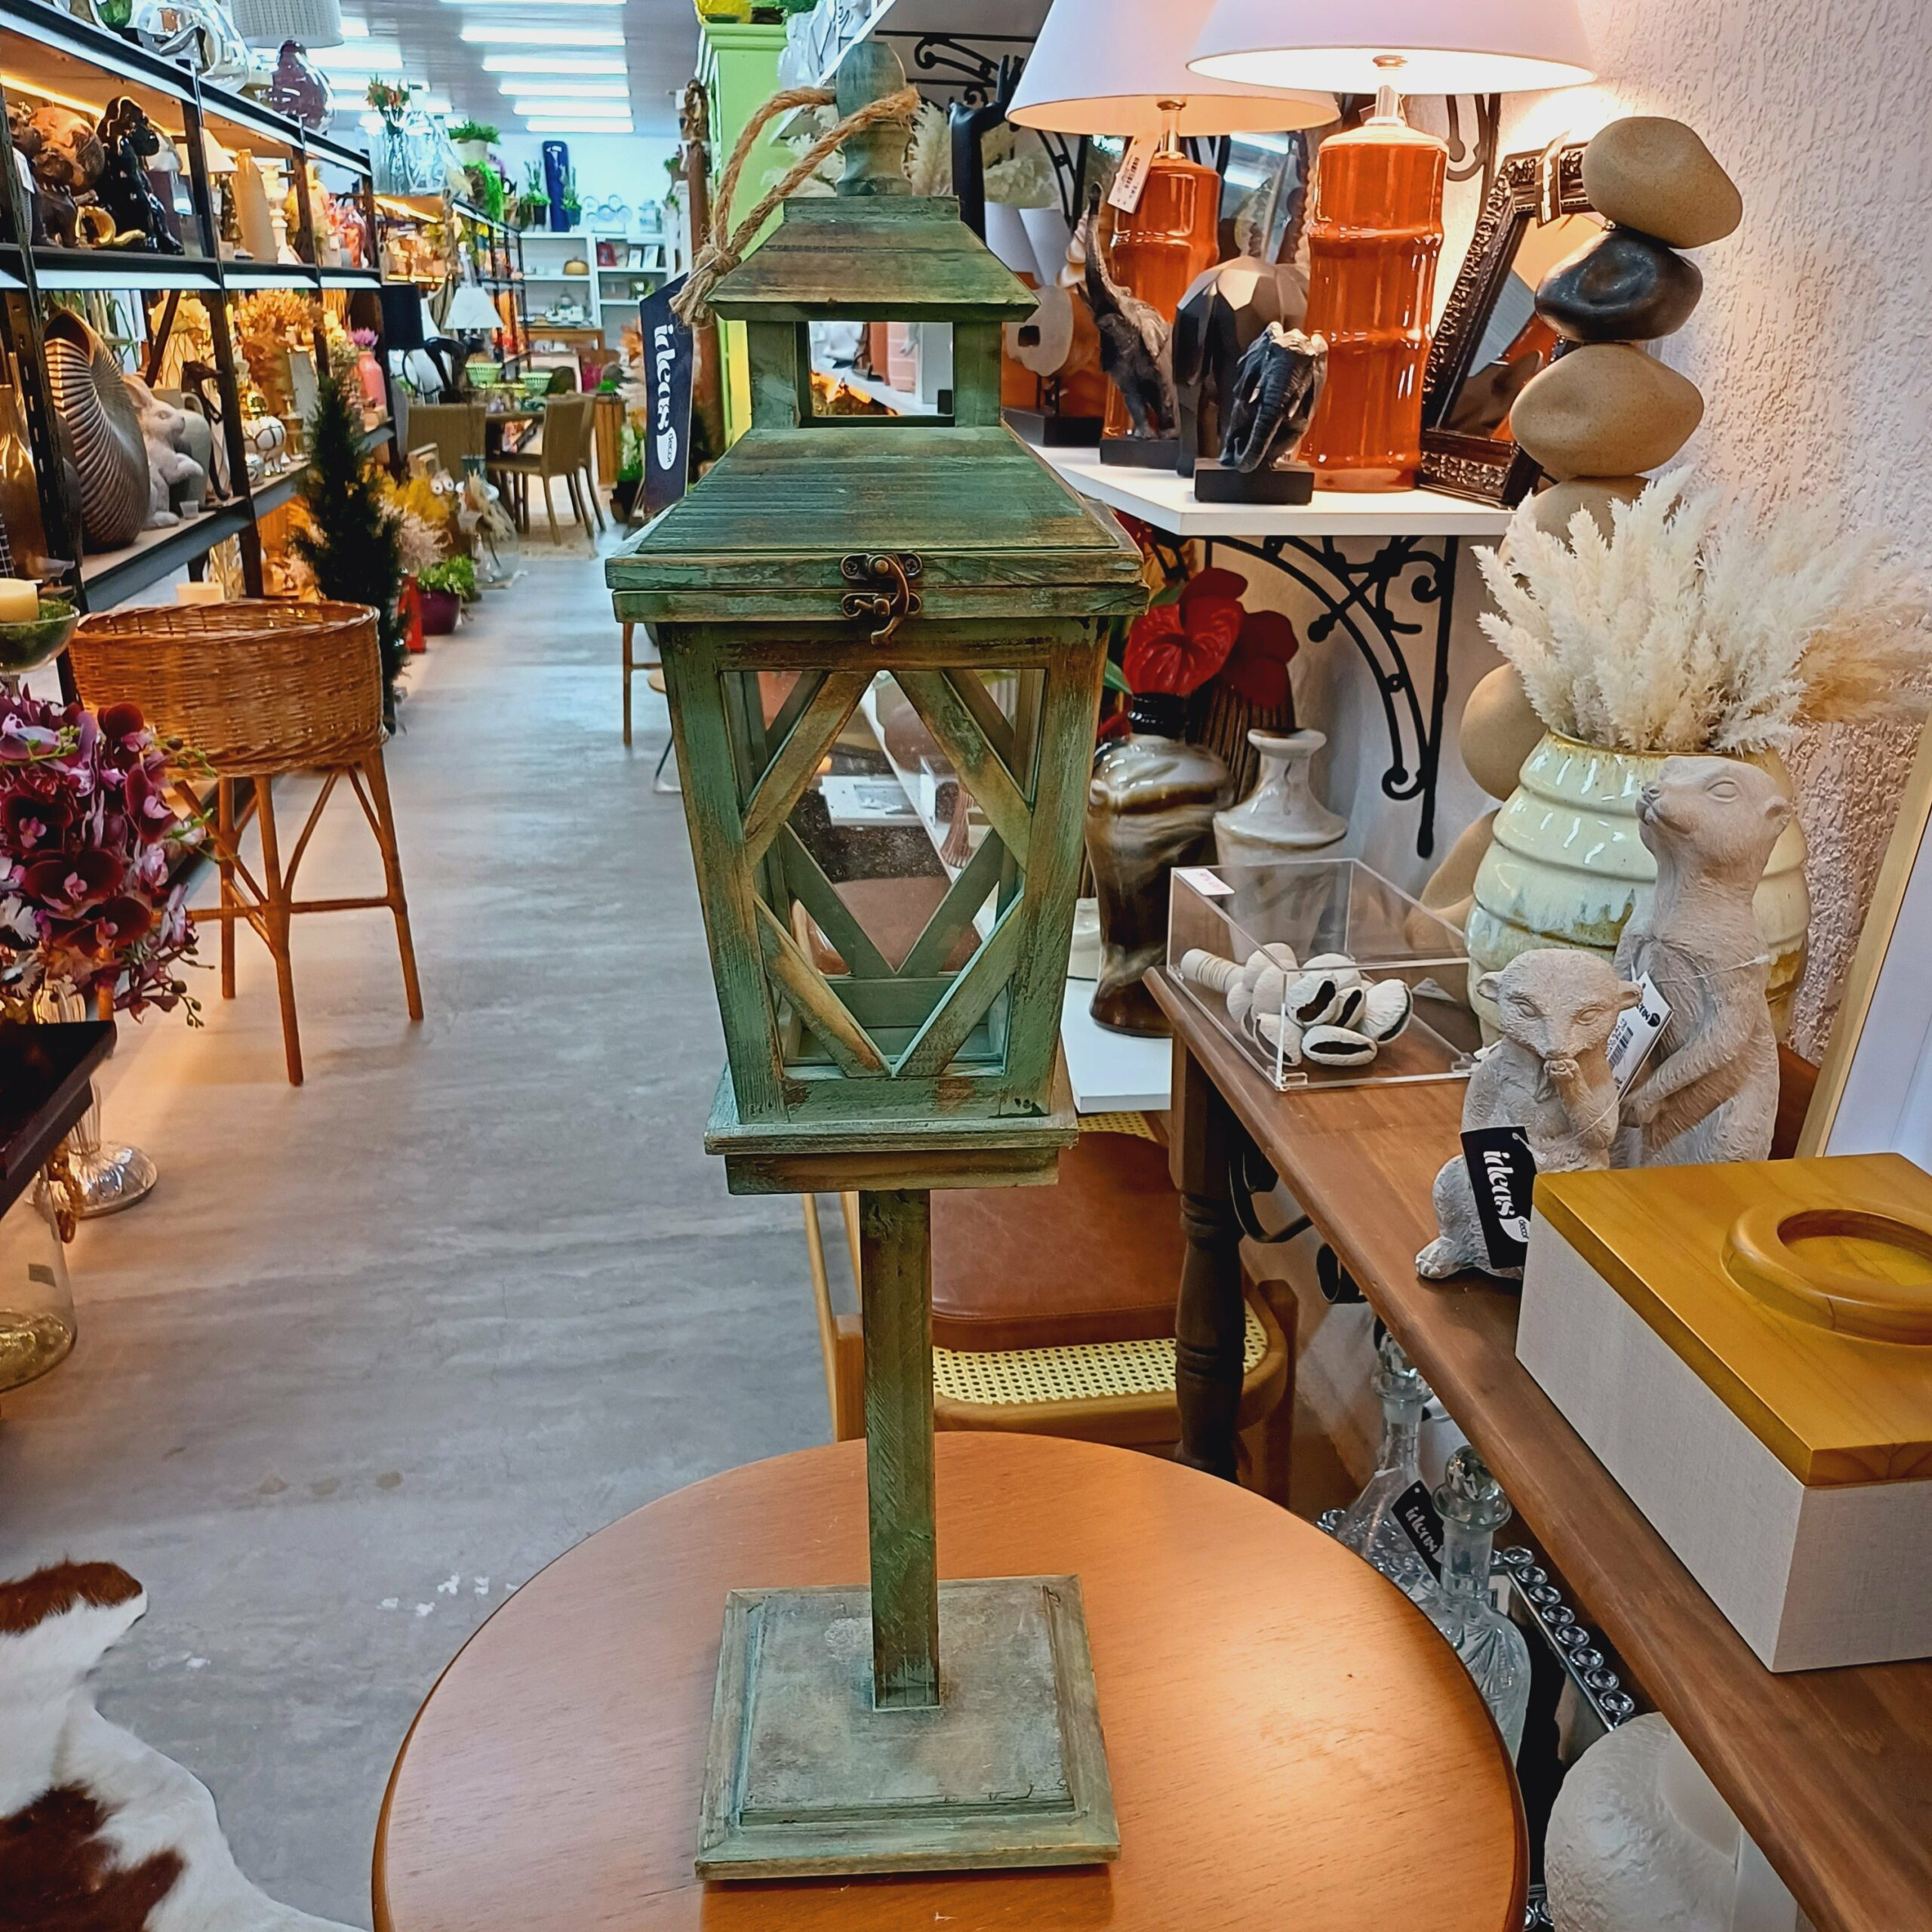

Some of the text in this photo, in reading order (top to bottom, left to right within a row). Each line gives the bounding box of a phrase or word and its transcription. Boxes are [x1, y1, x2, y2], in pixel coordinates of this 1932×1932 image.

[654, 323, 676, 431] ideas
[1482, 1150, 1515, 1217] ideas
[1405, 1506, 1438, 1552] ideas
